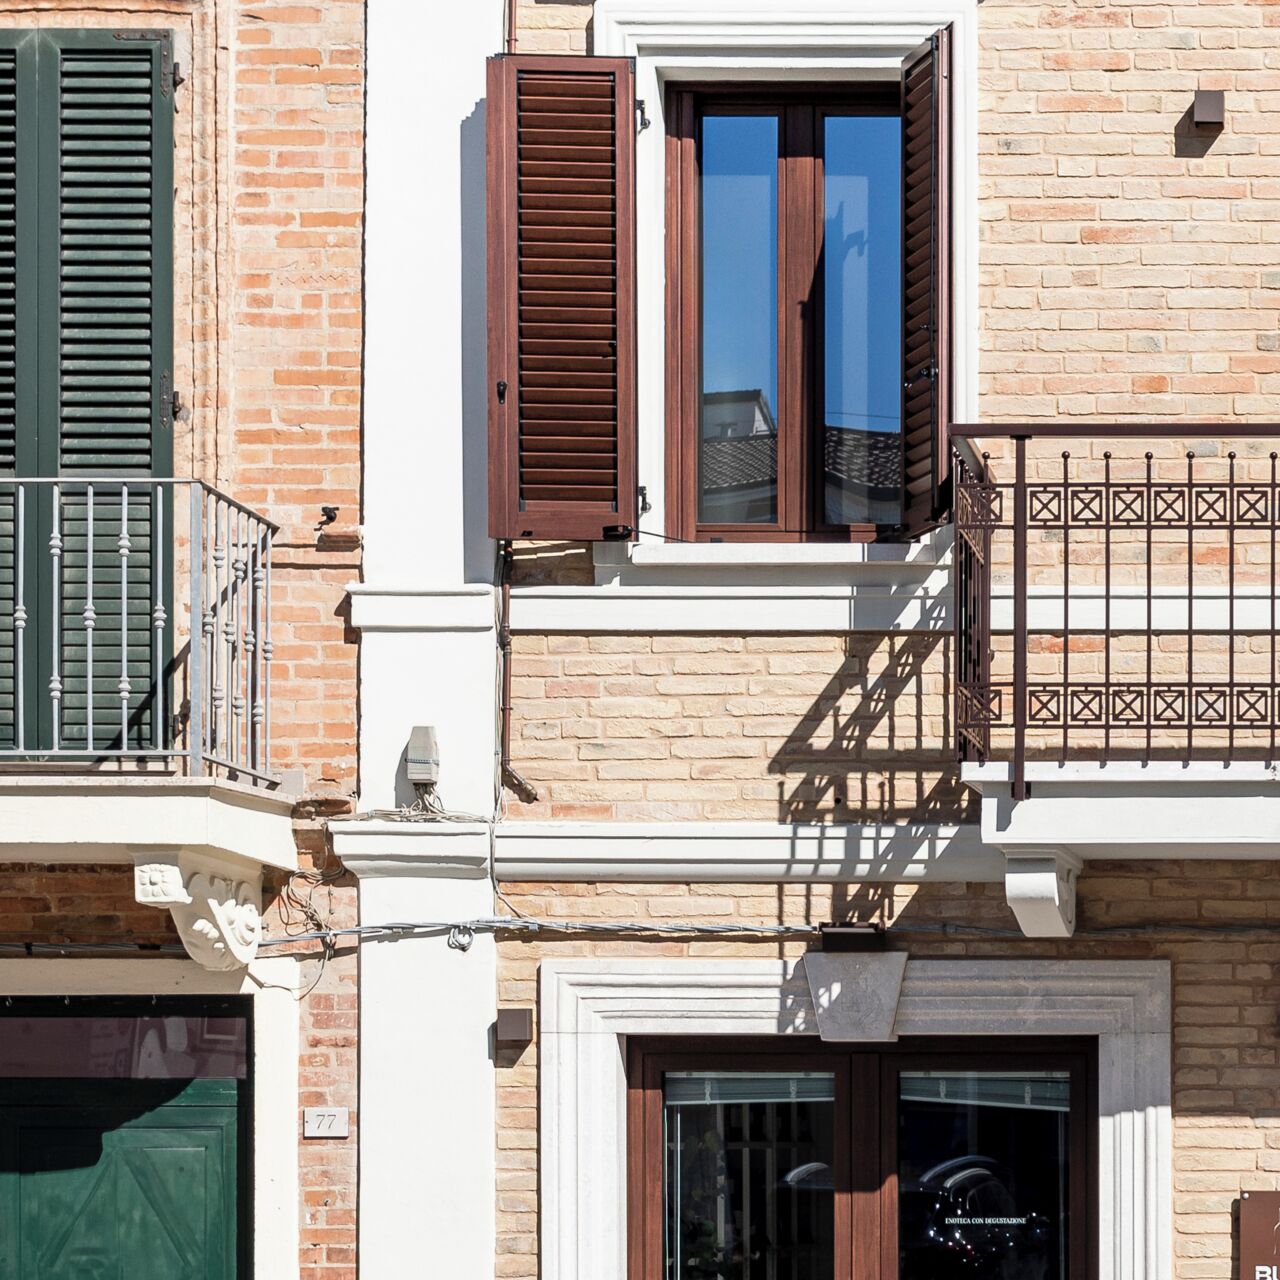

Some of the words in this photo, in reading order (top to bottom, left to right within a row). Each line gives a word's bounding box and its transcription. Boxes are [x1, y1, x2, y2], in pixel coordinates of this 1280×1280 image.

[316, 1114, 337, 1130] 77
[945, 1217, 971, 1225] ENOTECA
[972, 1217, 984, 1225] CON
[985, 1217, 1027, 1225] DEGUSTAZIONE
